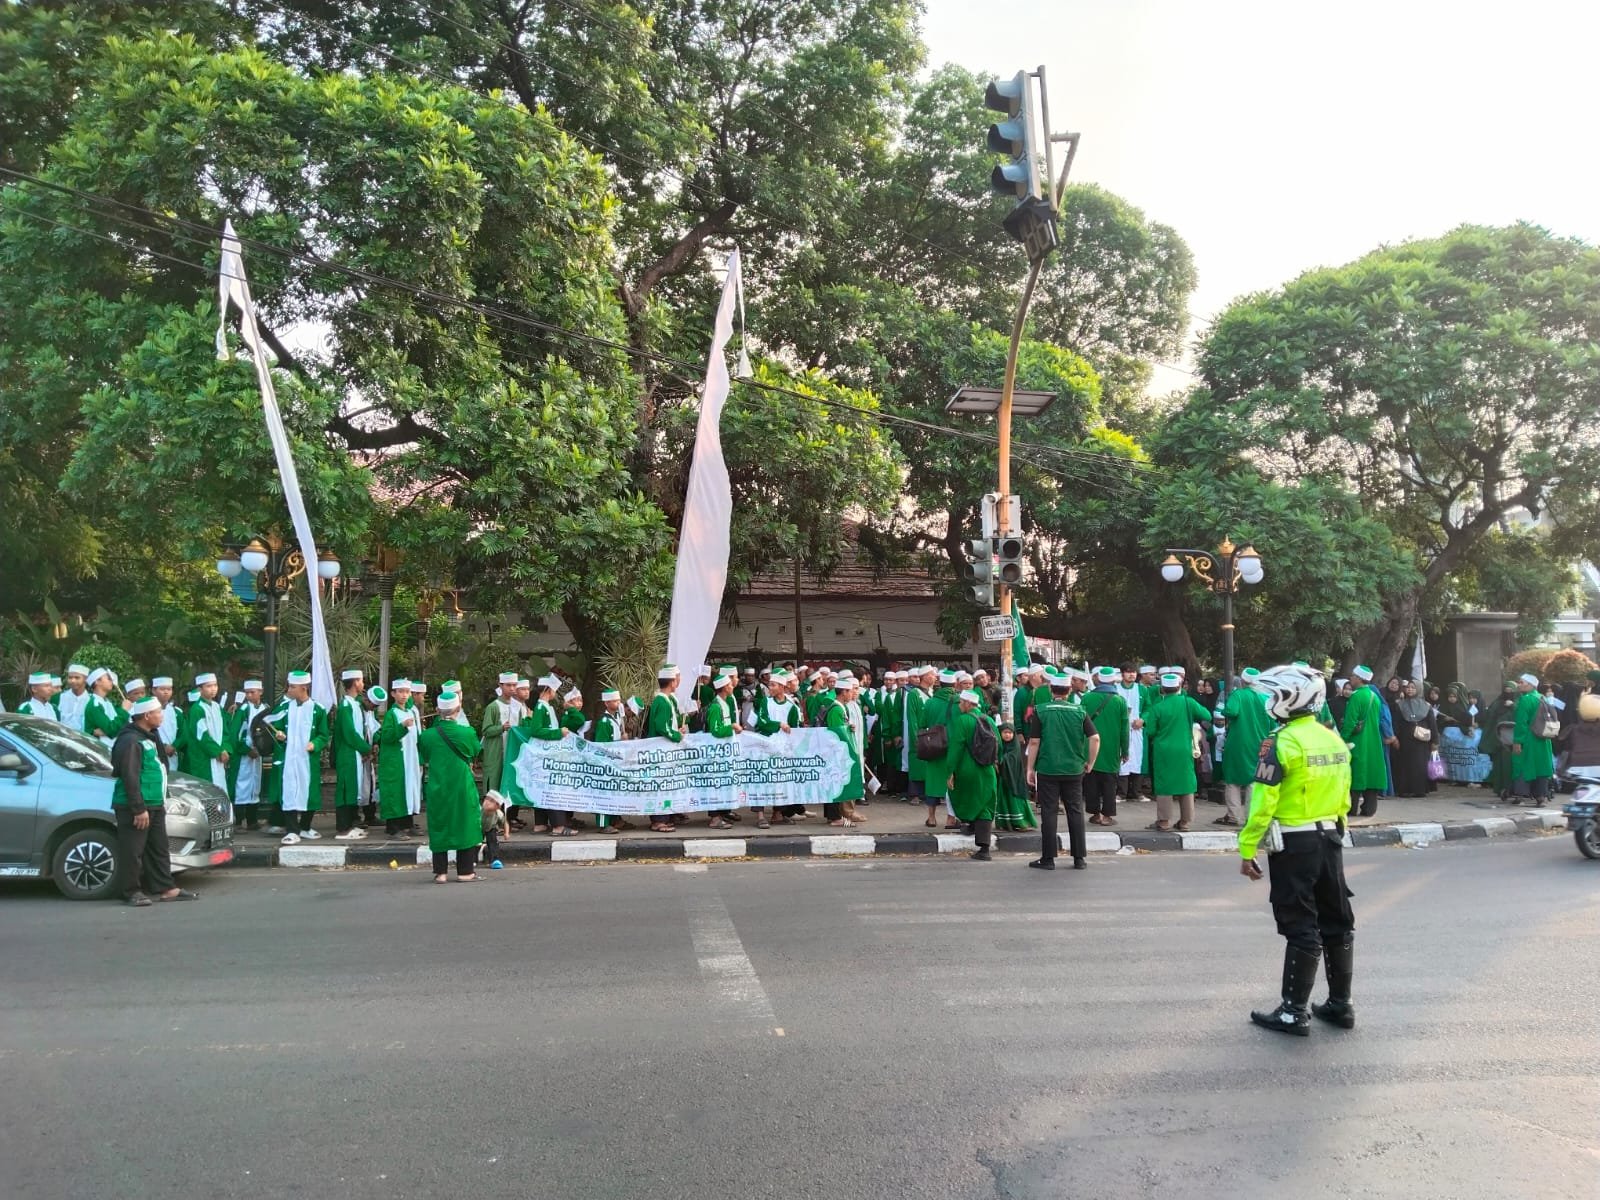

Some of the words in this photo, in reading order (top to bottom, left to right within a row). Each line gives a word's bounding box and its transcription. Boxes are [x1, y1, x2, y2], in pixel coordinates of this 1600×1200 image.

[638, 748, 699, 764] Muharram
[701, 743, 731, 759] 1448
[542, 758, 604, 775] Momentum
[605, 765, 645, 778] Ummat
[645, 766, 673, 778] Islam
[1256, 762, 1275, 780] M
[550, 774, 583, 789] Hidup
[584, 776, 618, 791] Penuh
[620, 780, 659, 792] Berkah
[660, 779, 687, 791] dalam
[687, 776, 732, 789] Naungan
[732, 771, 767, 786] Syariah
[768, 769, 819, 783] Islamiyyah
